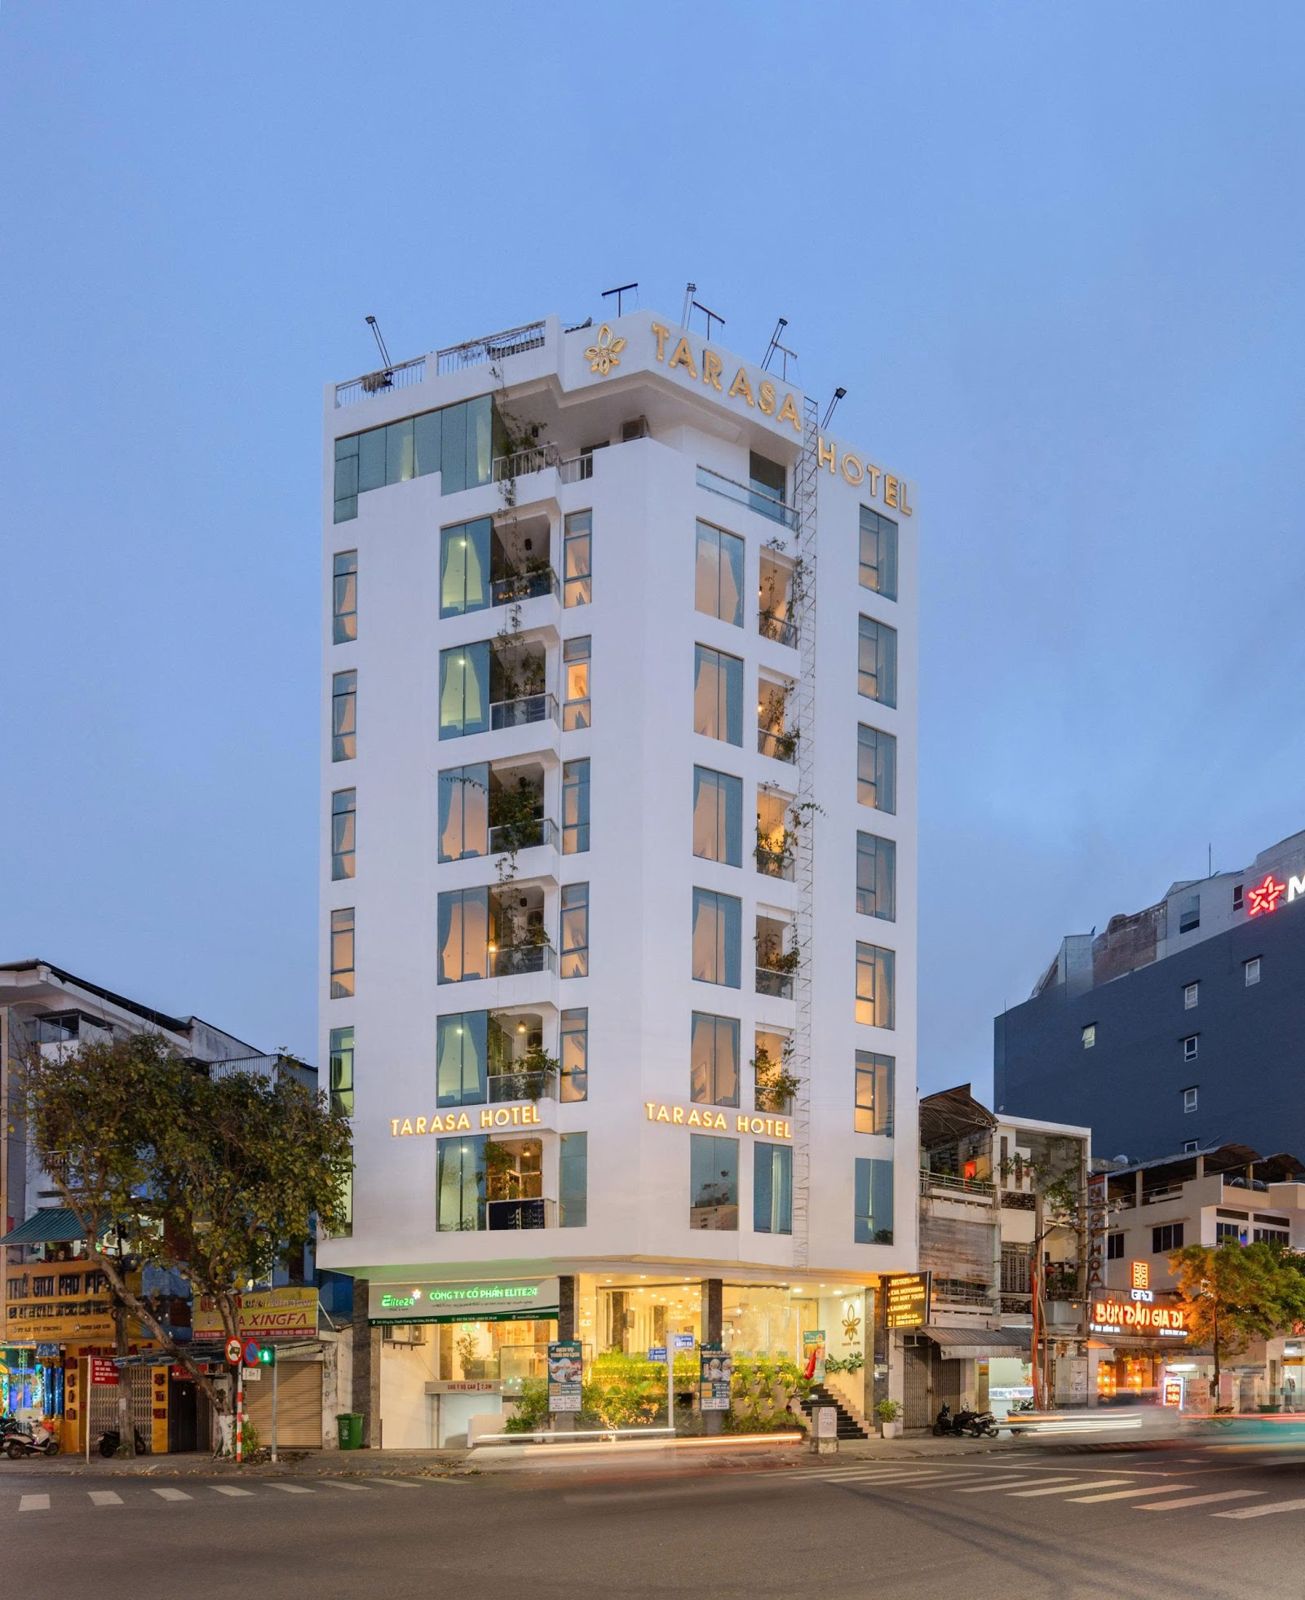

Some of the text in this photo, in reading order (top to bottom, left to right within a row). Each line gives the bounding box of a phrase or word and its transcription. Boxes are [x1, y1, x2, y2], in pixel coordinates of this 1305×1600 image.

[651, 321, 913, 516] TARASA HOTEL
[391, 1105, 541, 1136] TARASA HOTEL
[646, 1102, 792, 1138] TARASA HOTEL
[453, 1290, 465, 1300] TY
[249, 1312, 308, 1326] XINGFA
[1151, 1308, 1170, 1329] GIA
